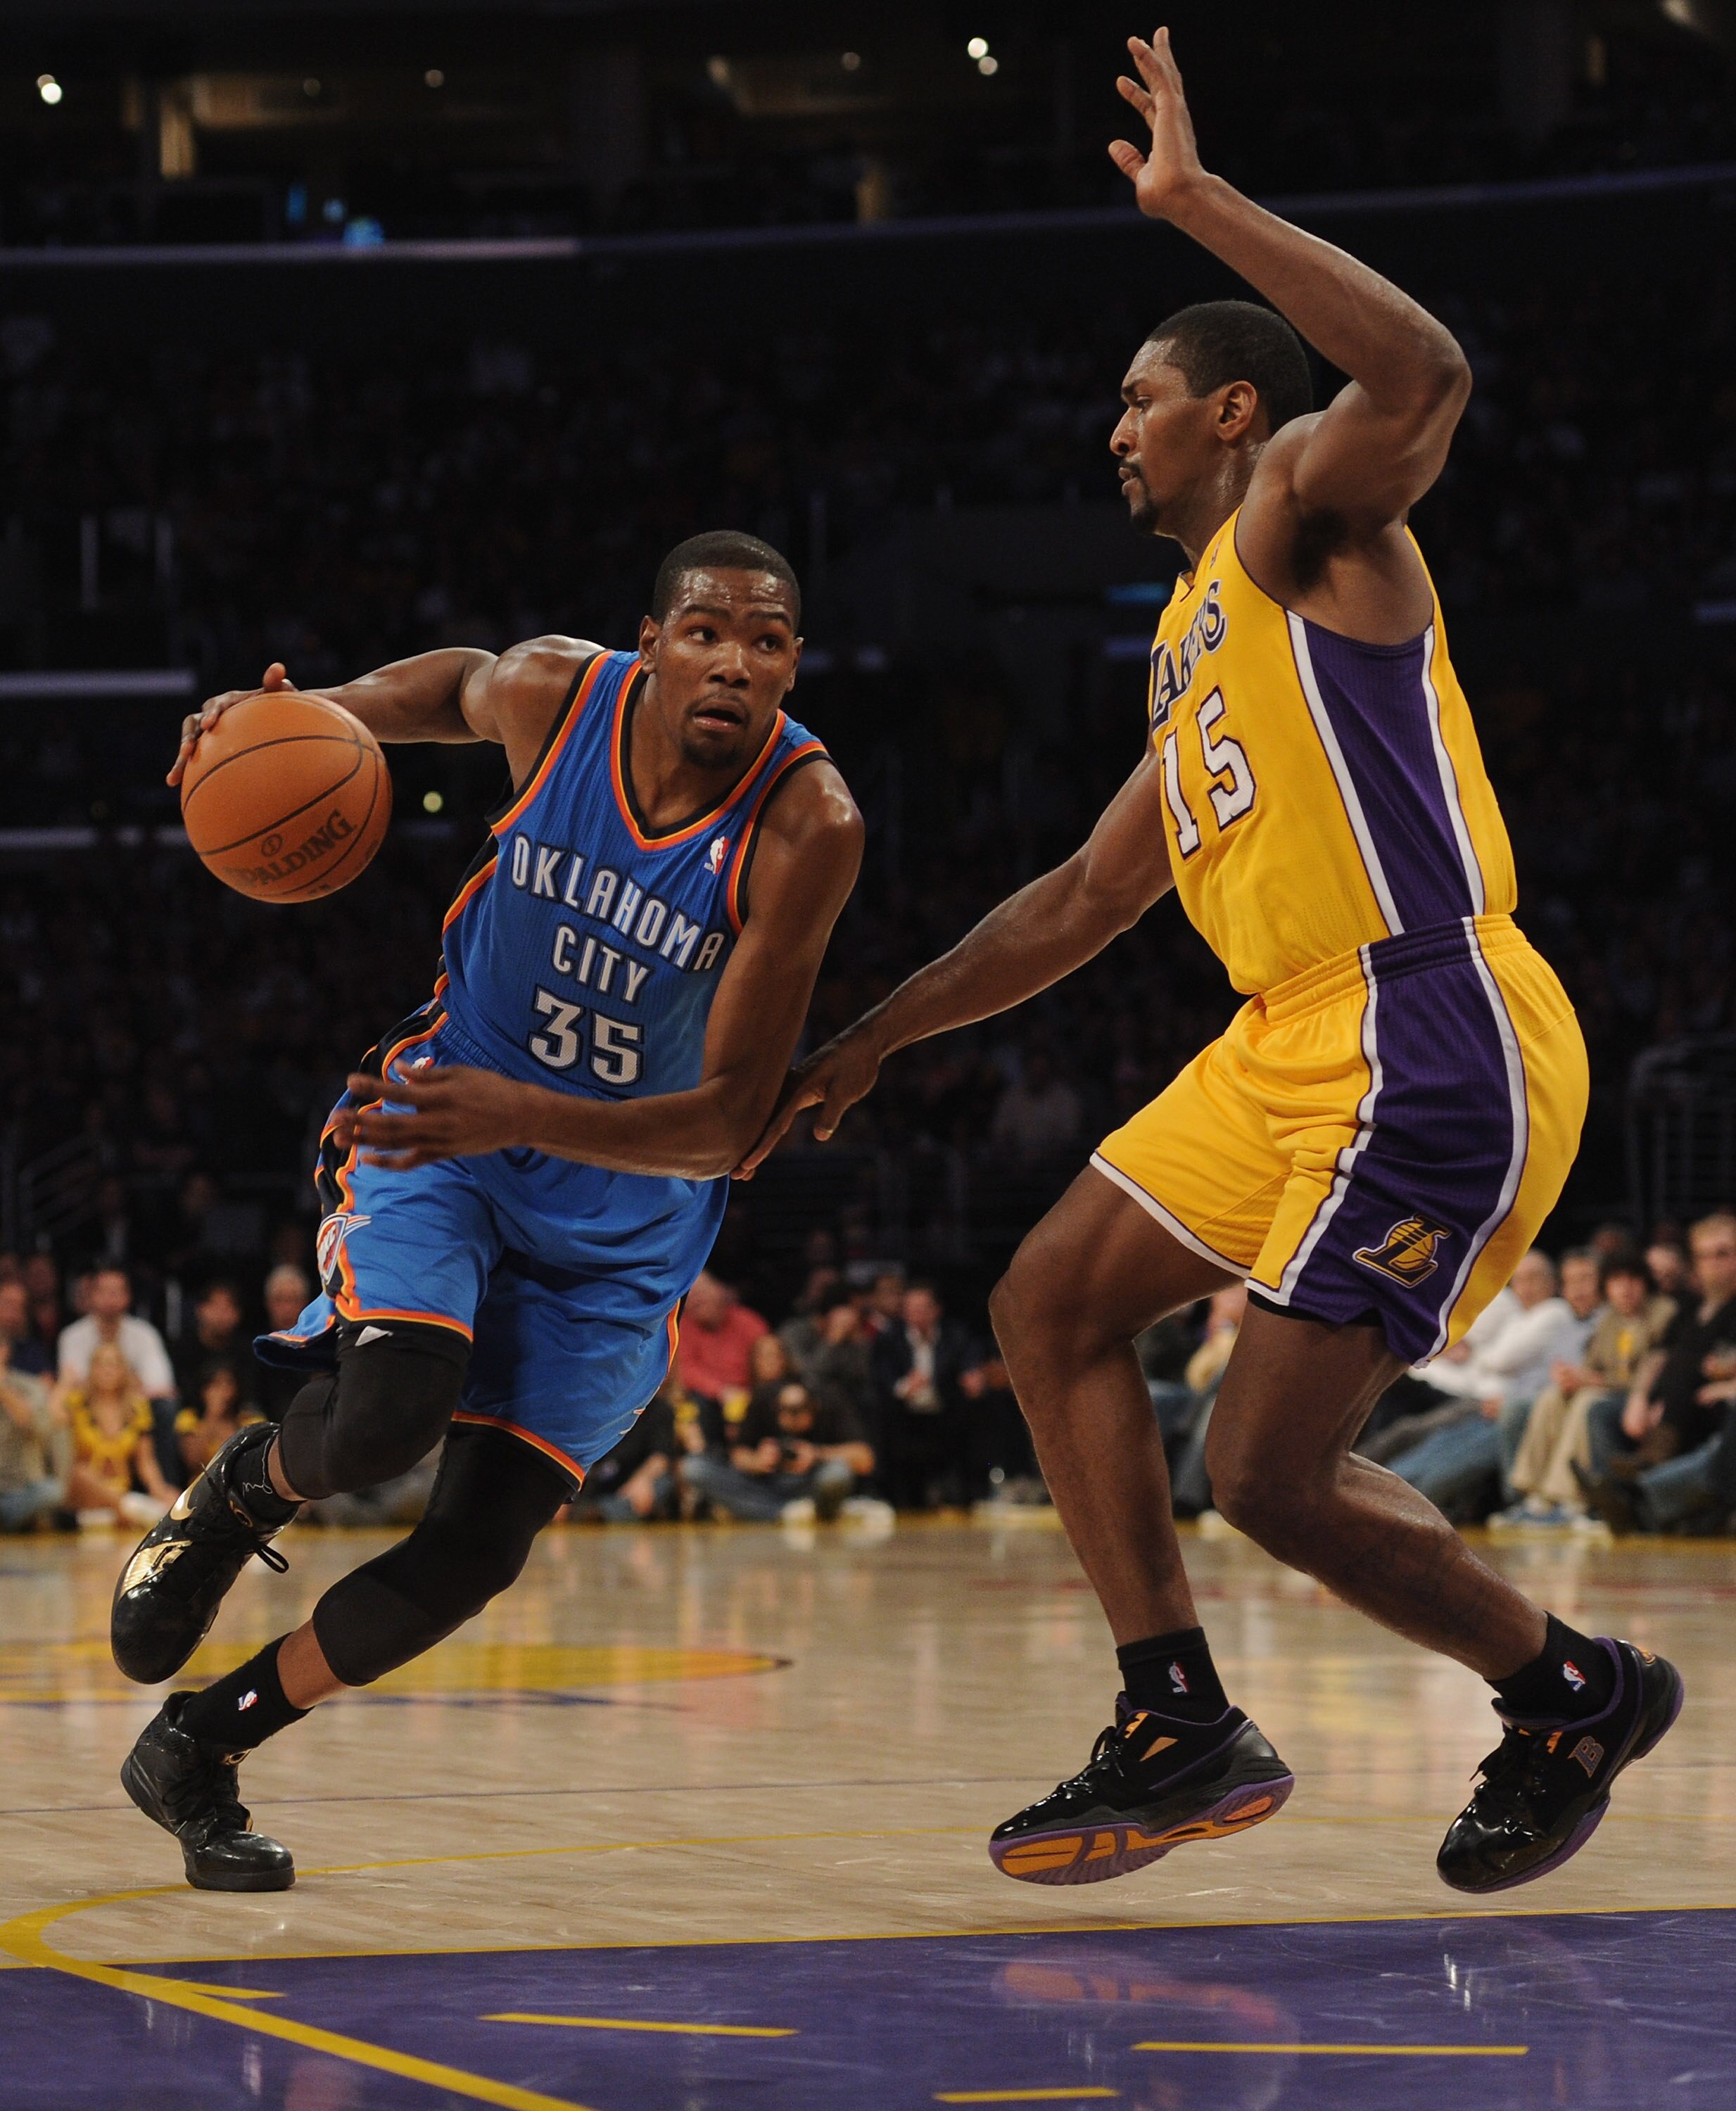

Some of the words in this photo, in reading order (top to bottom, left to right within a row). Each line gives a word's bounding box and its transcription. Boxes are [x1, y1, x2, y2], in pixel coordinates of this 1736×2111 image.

[1161, 685, 1257, 861] 15
[510, 832, 727, 972] OKLAHOMA
[552, 924, 652, 1003] CITY
[529, 985, 644, 1085] 35
